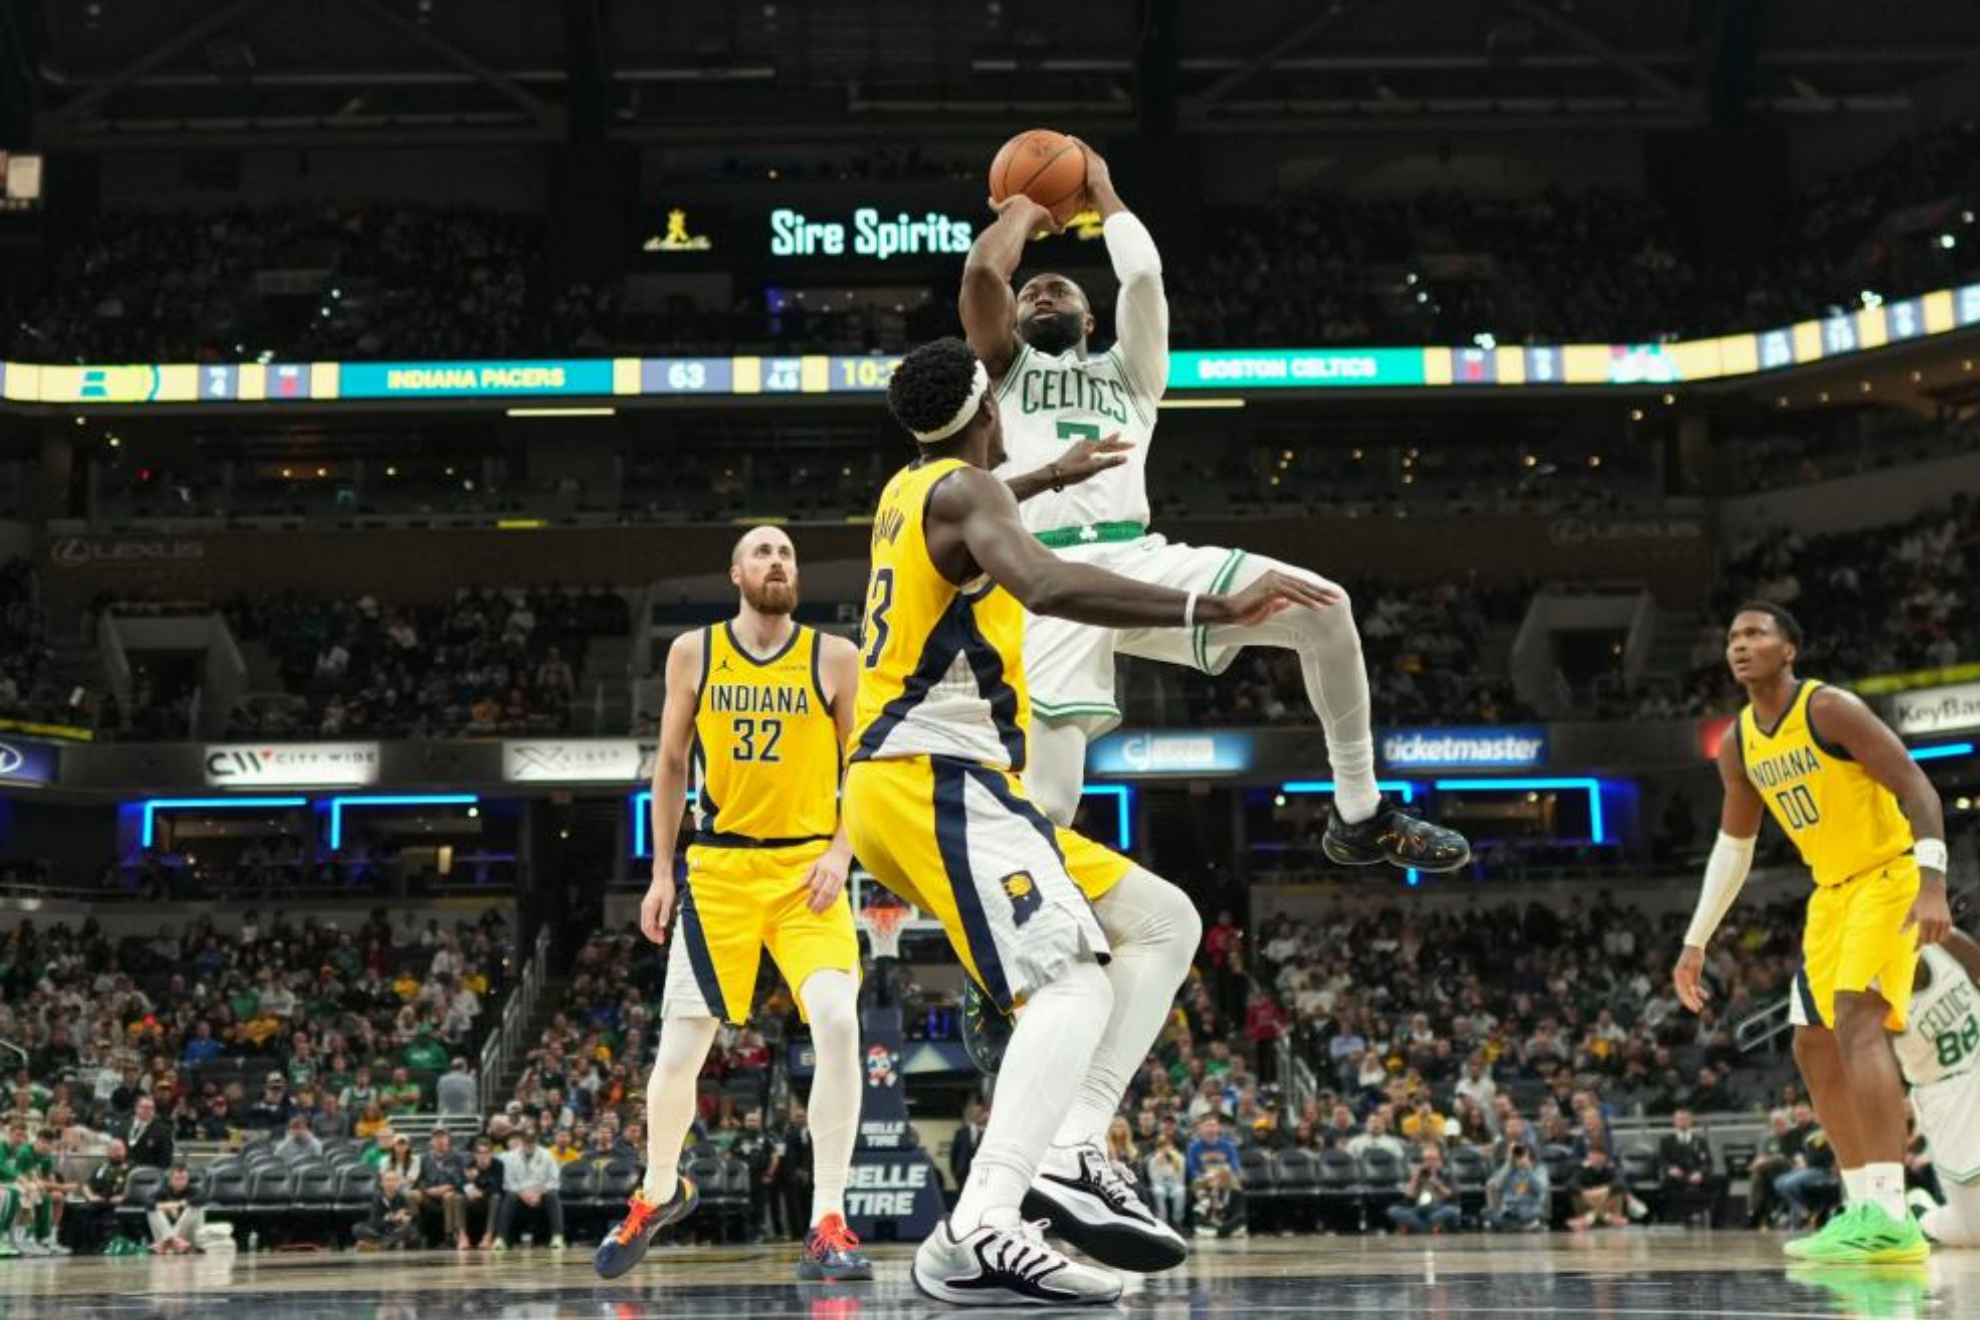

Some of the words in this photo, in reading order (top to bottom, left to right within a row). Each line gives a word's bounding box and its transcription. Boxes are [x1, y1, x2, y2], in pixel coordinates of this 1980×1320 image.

[771, 208, 844, 255] Sire
[854, 208, 972, 259] Spirits
[388, 369, 477, 389] INDIANA
[481, 367, 565, 387] PACERS
[667, 363, 705, 389] 63
[1199, 358, 1287, 379] BOSTON
[1290, 357, 1377, 377] CELTICS
[1022, 367, 1127, 424] CELTICS
[94, 542, 204, 559] LEXUS
[861, 567, 893, 668] 3
[711, 685, 808, 714] INDIANA
[1898, 697, 1980, 726] KeyBa
[733, 719, 782, 762] 32
[1383, 734, 1544, 762] ticketmaster
[276, 752, 318, 765] CITY
[328, 751, 376, 764] WIDE
[1776, 783, 1821, 830] 00
[1936, 1013, 1979, 1066] 88
[861, 1122, 905, 1135] BELLE
[866, 1135, 900, 1148] TIRE
[846, 1191, 915, 1216] TIRE
